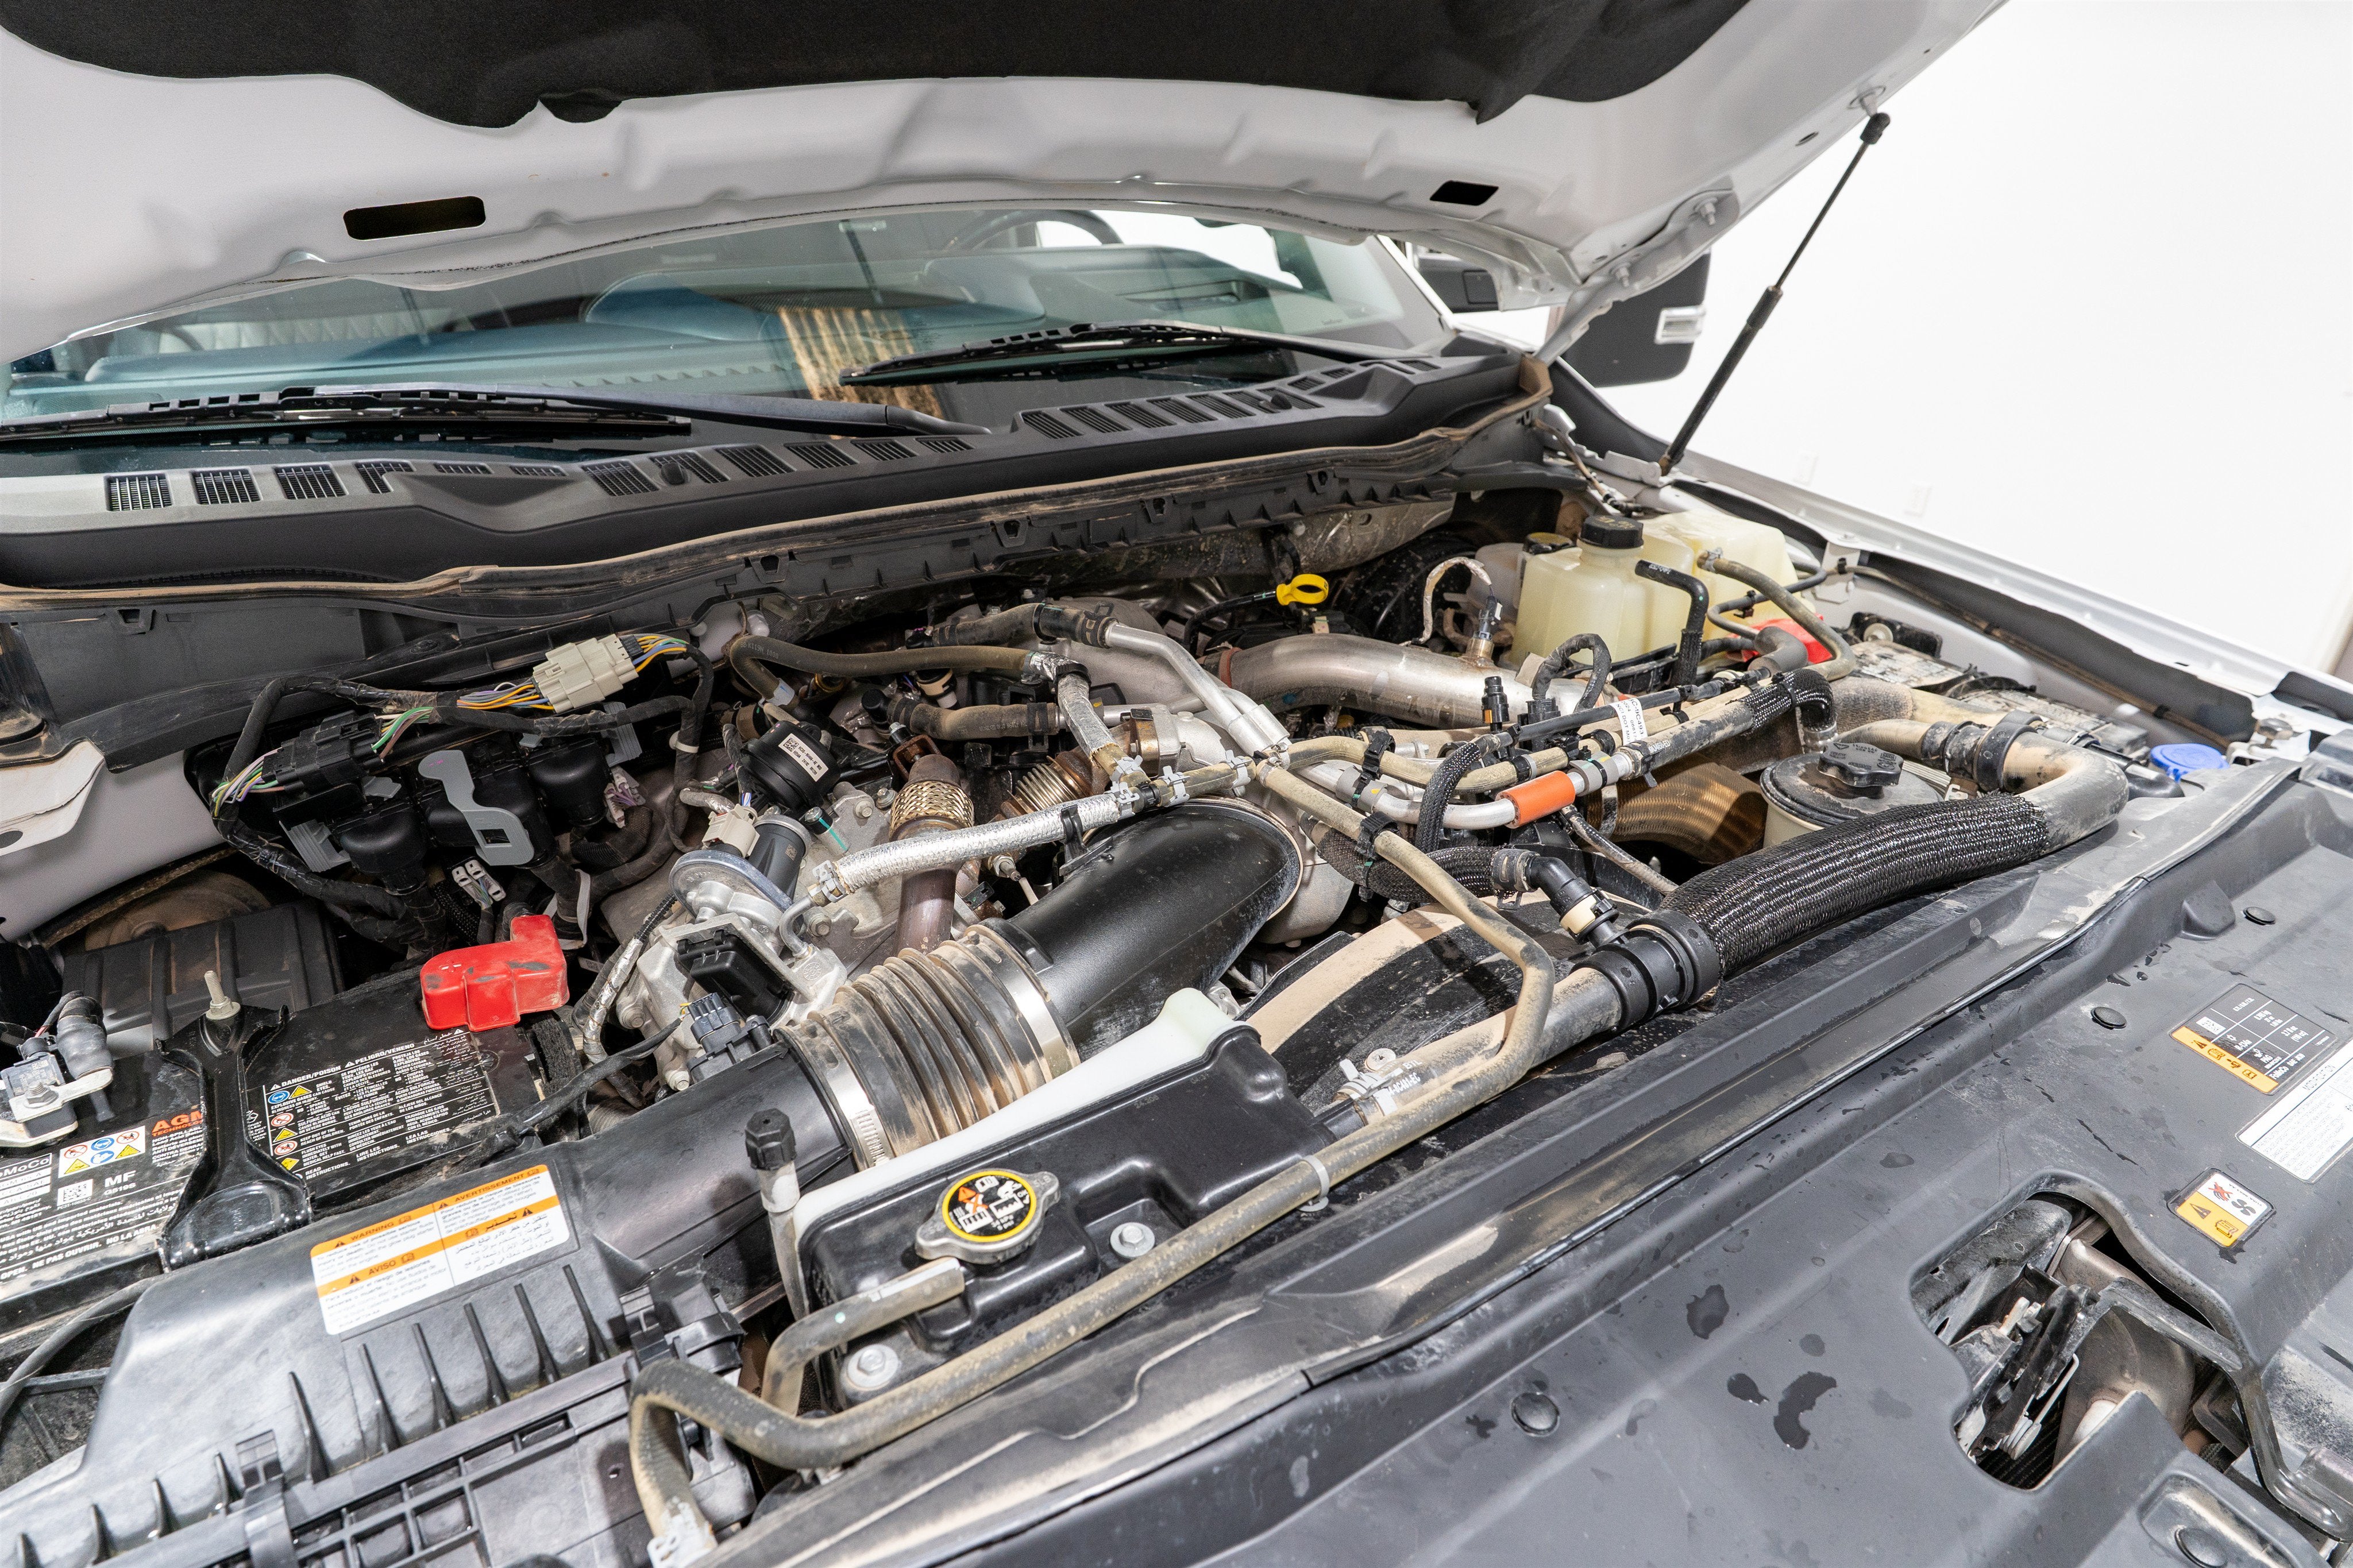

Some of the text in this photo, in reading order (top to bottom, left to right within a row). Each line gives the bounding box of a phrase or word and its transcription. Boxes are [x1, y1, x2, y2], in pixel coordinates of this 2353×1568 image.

[281, 1043, 414, 1087] DANGER/POISON PELIGRO/VENENO
[409, 1080, 435, 1091] SULFÚRICO
[2302, 1065, 2335, 1090] MODIFICATION
[271, 1099, 296, 1110] EXPLOSIVE
[296, 1094, 312, 1102] GASES
[343, 1094, 389, 1112] L'ACIDE SULFURIQUE
[298, 1116, 320, 1127] SULFURIC
[322, 1129, 345, 1139] CHILDREN.
[407, 1127, 452, 1144] INSTRUCCIONES.
[152, 1149, 178, 1160] CONTRA
[357, 1144, 399, 1161] INSTRUCTIONS.
[303, 1157, 322, 1167] MEDICAL
[306, 1162, 350, 1179] INSTRUCTIONS.
[105, 1170, 136, 1187] MF
[305, 1167, 321, 1175] READ
[456, 1174, 523, 1202] AVERTISSEMENT
[16, 1229, 32, 1237] with
[351, 1223, 394, 1240] WARNING
[0, 1224, 159, 1279] OPEN. NE PAS OUVRIR. NO LA ABRA.
[369, 1260, 396, 1275] AVISO
